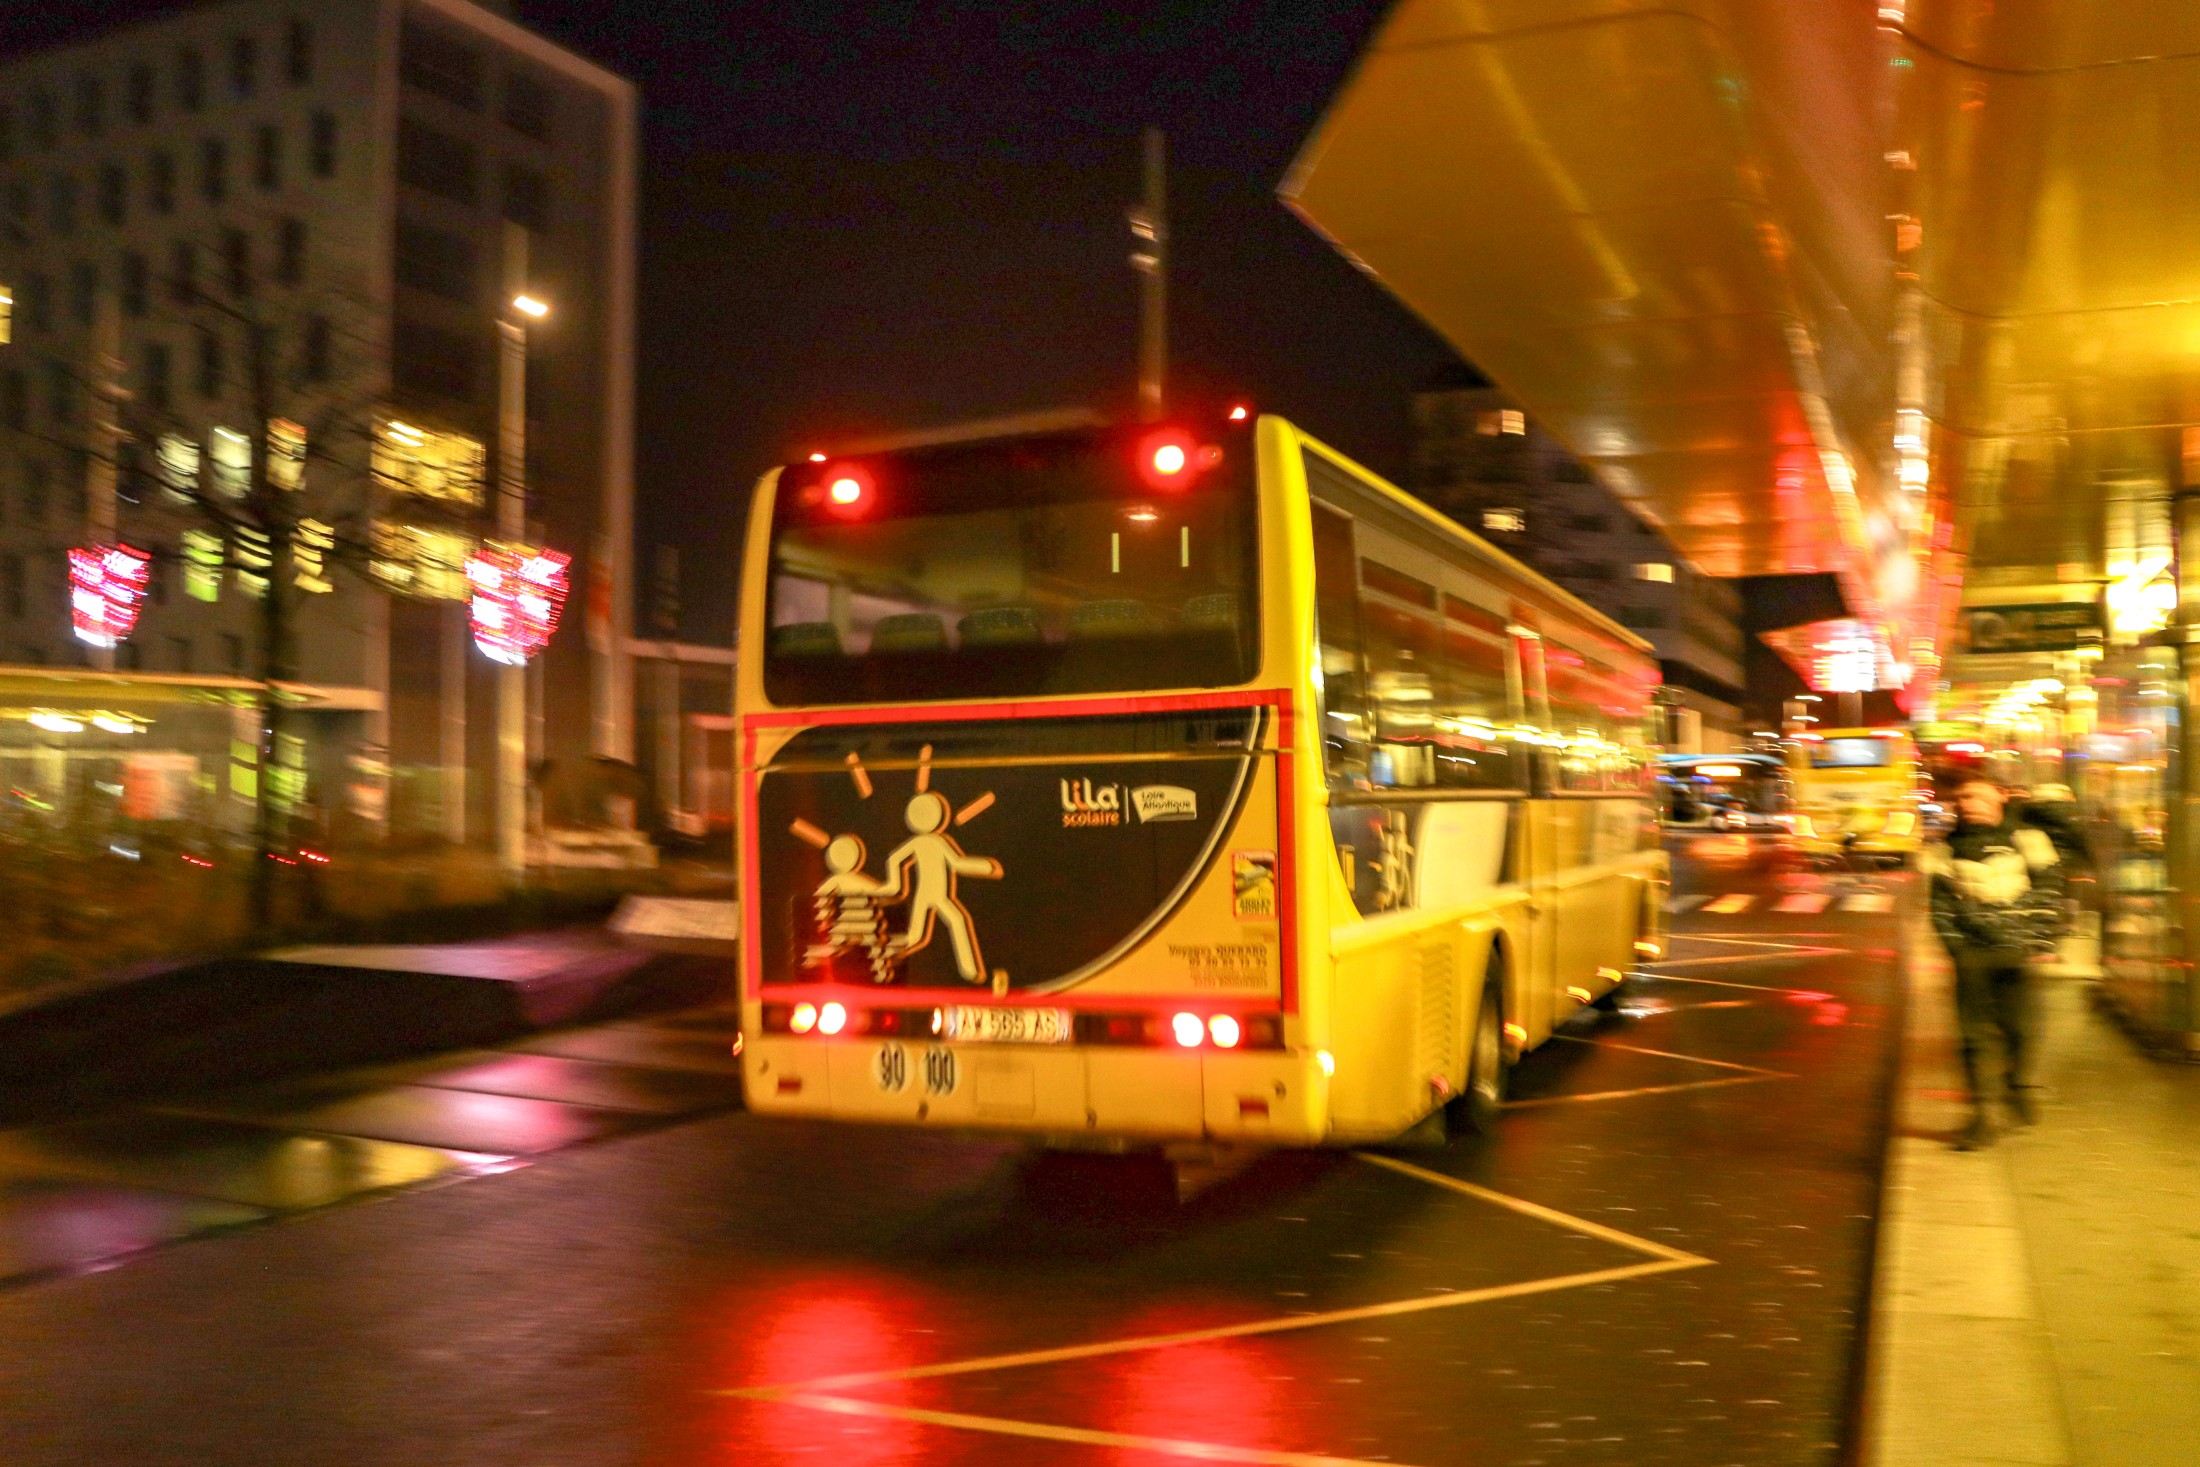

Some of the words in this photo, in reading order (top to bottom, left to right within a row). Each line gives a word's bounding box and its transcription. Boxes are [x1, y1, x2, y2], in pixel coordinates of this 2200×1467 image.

[1061, 810, 1120, 828] scolaire
[879, 1043, 905, 1092] 90
[924, 1045, 956, 1096] 100
